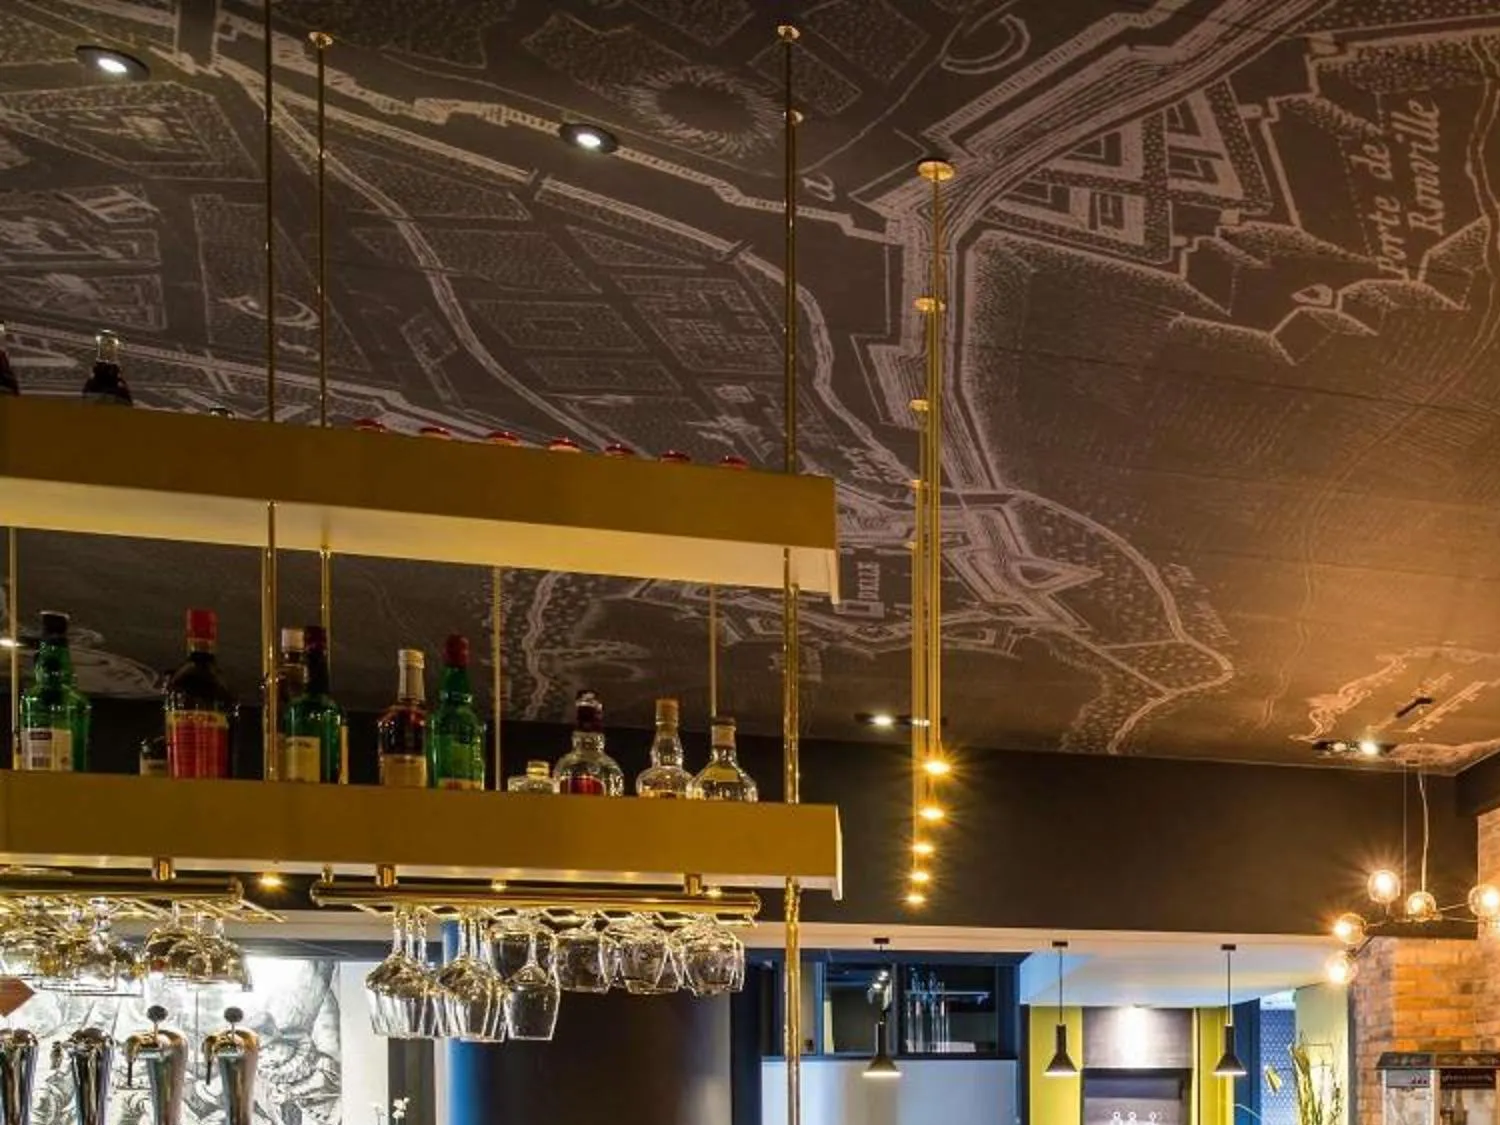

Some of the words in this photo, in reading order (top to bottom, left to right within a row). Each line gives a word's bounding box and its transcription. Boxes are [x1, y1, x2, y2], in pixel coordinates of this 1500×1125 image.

[1350, 143, 1393, 181] de
[1391, 99, 1446, 236] Ronville
[1368, 196, 1410, 285] Porte
